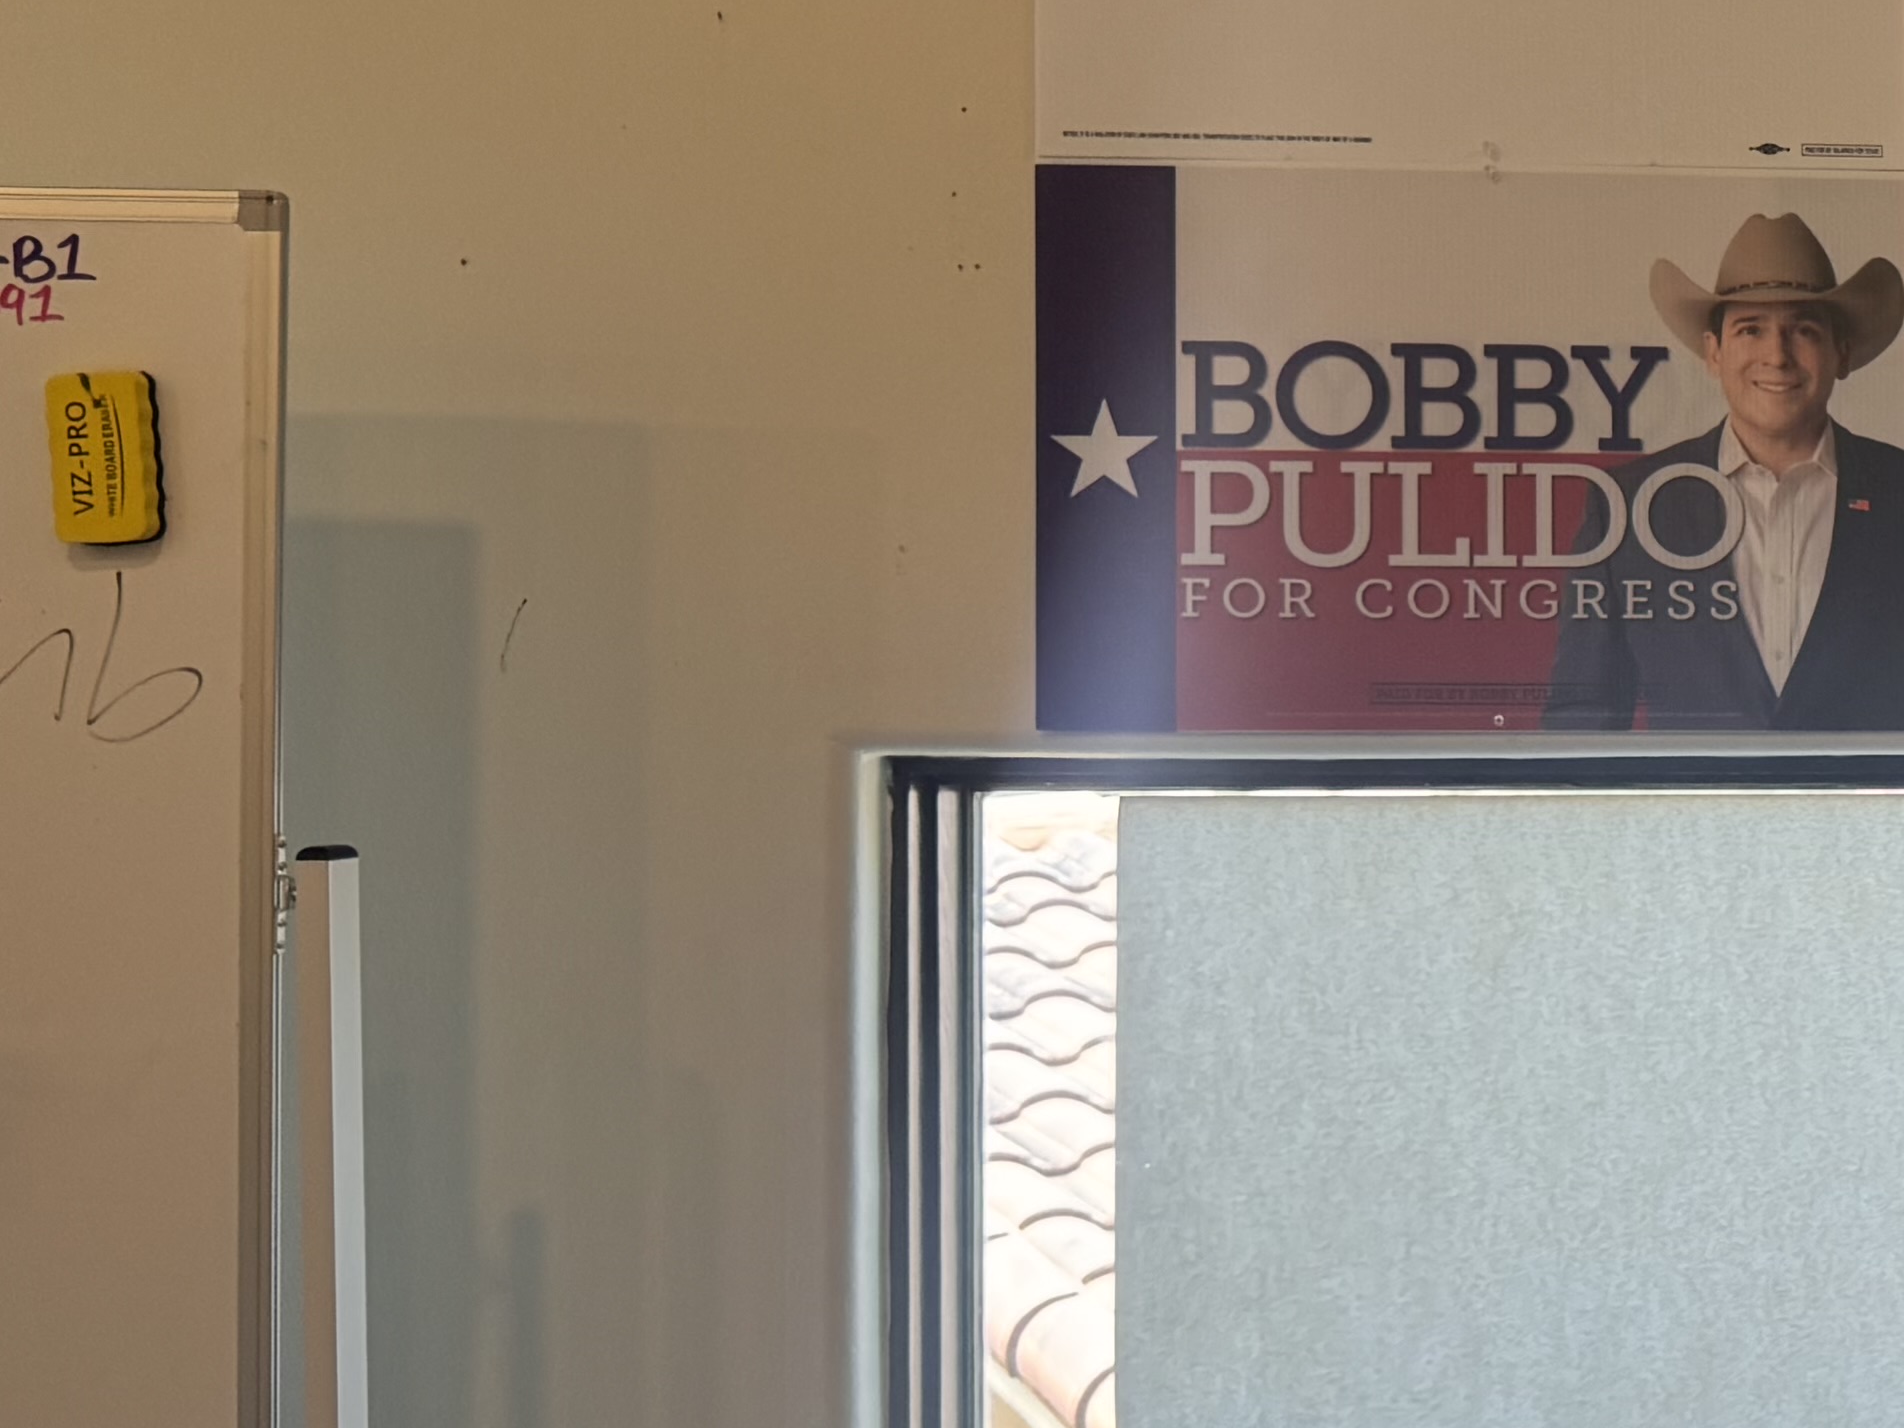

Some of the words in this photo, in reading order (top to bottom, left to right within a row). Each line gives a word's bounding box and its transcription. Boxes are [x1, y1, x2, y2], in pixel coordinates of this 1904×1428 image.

[1181, 340, 1670, 452] BOBBY
[65, 400, 95, 517] VIZ-PRO
[104, 439, 118, 480] BOARD
[1180, 459, 1746, 571] PULIDO
[1180, 578, 1316, 619] FOR
[1355, 578, 1741, 621] CONGRESS
